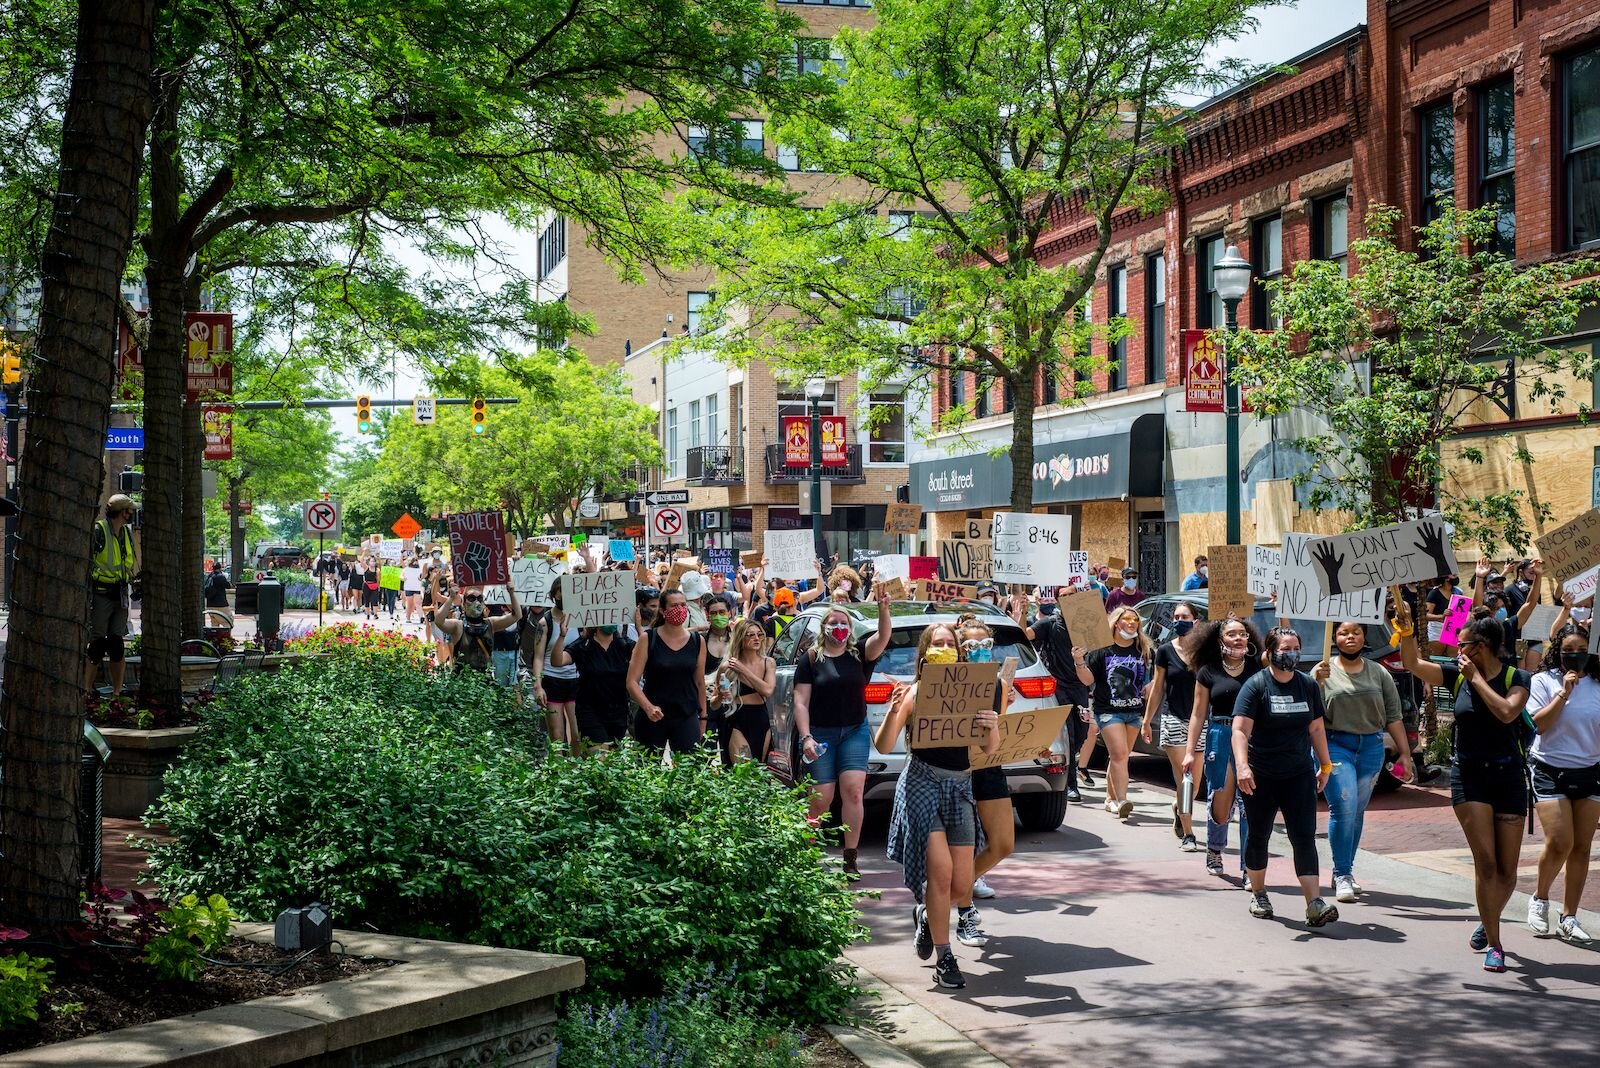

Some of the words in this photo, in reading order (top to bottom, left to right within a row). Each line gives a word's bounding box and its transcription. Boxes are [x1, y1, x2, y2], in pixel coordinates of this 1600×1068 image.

[107, 434, 139, 443] South
[1033, 461, 1047, 480] CO
[1075, 453, 1109, 478] BOB'S
[928, 471, 948, 492] South
[950, 467, 975, 489] Street
[448, 511, 500, 531] PROTECT
[1028, 526, 1059, 545] 8:46
[1348, 528, 1400, 559] DON'T
[1537, 524, 1580, 554] RACISM
[1582, 515, 1597, 529] IS
[450, 532, 467, 584] BLACK
[493, 530, 506, 581] LIVES
[709, 549, 733, 557] BLACK
[710, 557, 731, 565] LIVES
[942, 541, 970, 580] NO
[968, 544, 993, 562] JUSTIC
[1069, 552, 1087, 562] IVES
[1256, 546, 1280, 567] RACIS
[1285, 536, 1312, 567] NO
[1549, 546, 1571, 567] NOT
[1574, 535, 1591, 551] AND
[708, 565, 735, 573] MATTER
[971, 562, 993, 579] PEAC
[1351, 553, 1416, 588] SHOOT
[1556, 556, 1591, 582] SHOULD
[513, 574, 544, 589] IVES
[572, 574, 624, 594] BLACK
[926, 582, 966, 599] BLACK
[484, 588, 556, 603] MATER
[580, 591, 618, 606] LIVES
[1282, 578, 1307, 614] NO
[566, 606, 634, 628] MATTER
[944, 665, 968, 684] NO
[926, 682, 994, 699] JUSTICE
[941, 699, 967, 714] NO
[984, 750, 1009, 766] THE
